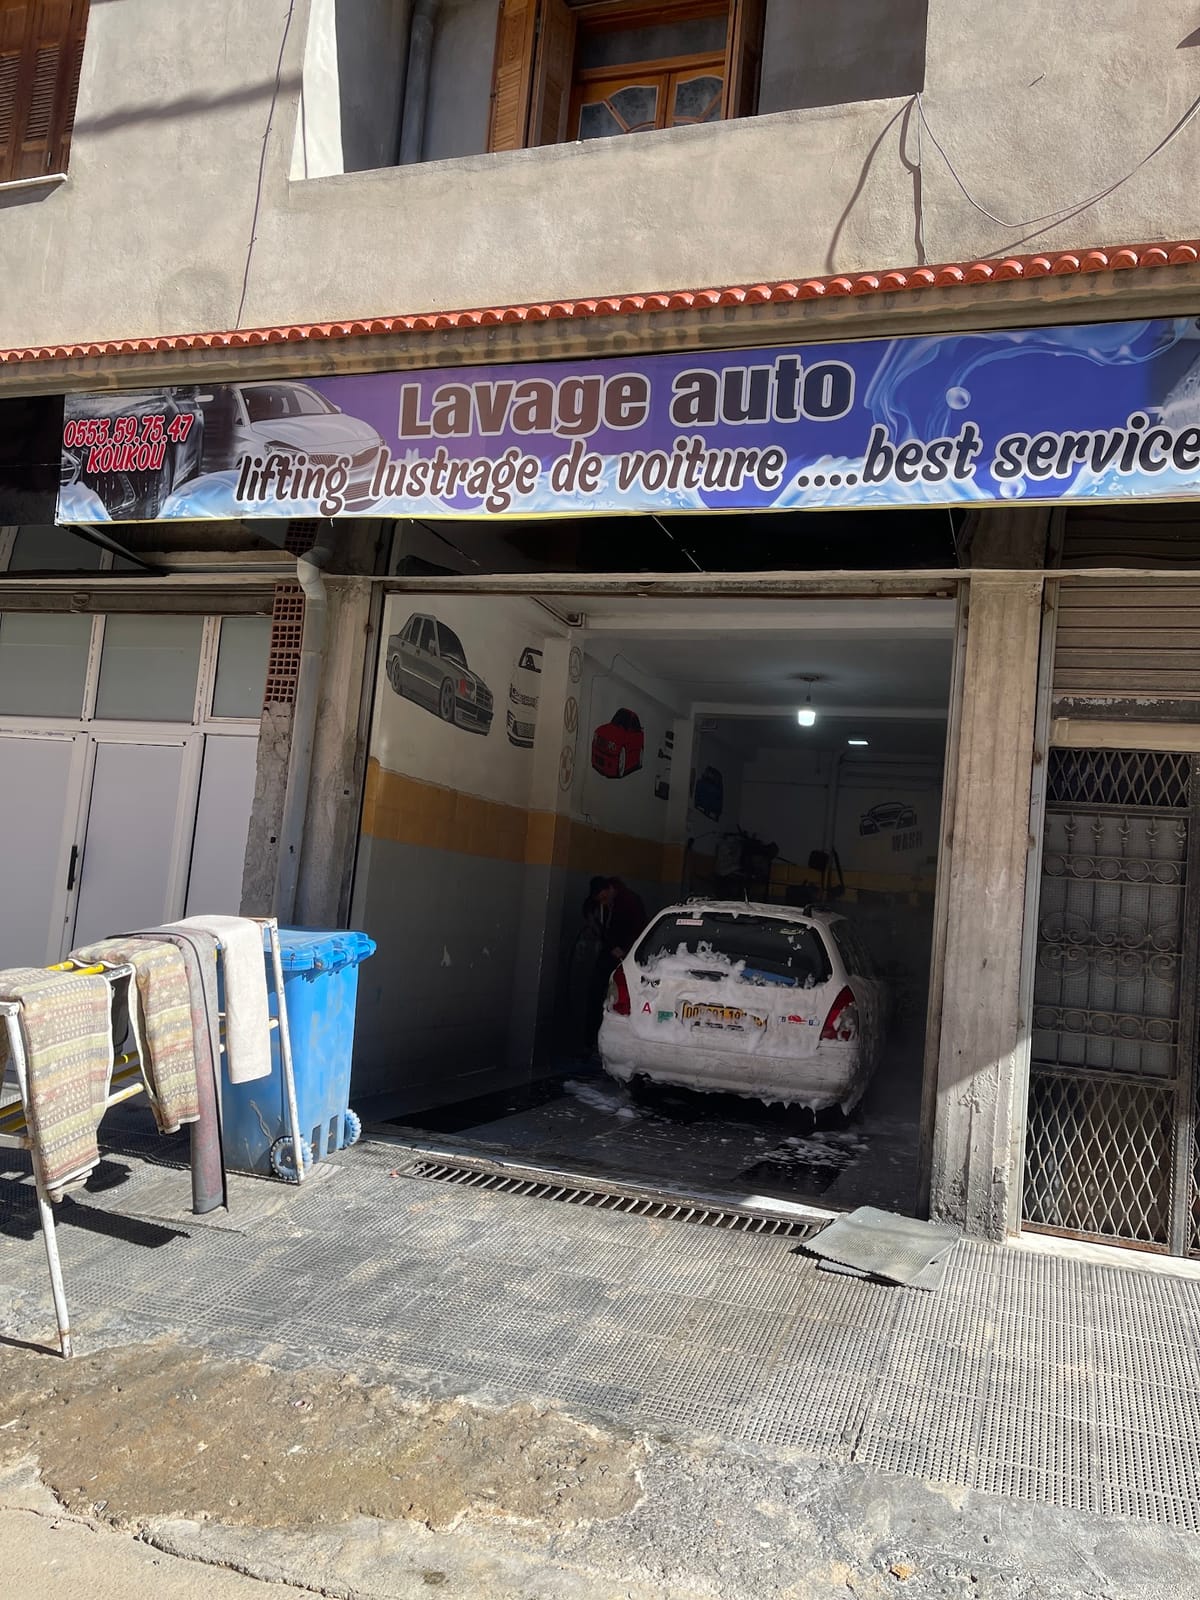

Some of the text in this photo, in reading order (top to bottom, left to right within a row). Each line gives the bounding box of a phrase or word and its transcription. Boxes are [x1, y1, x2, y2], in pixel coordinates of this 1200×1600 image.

[400, 358, 852, 436] Lavage auto
[64, 414, 194, 447] 0553.59.75.47
[87, 443, 166, 473] KOUKOU
[236, 454, 351, 517] lifting
[371, 449, 539, 513] lustrage
[551, 440, 602, 493] de
[618, 438, 784, 491] voiture
[994, 415, 1200, 478] service
[641, 1001, 651, 1014] A
